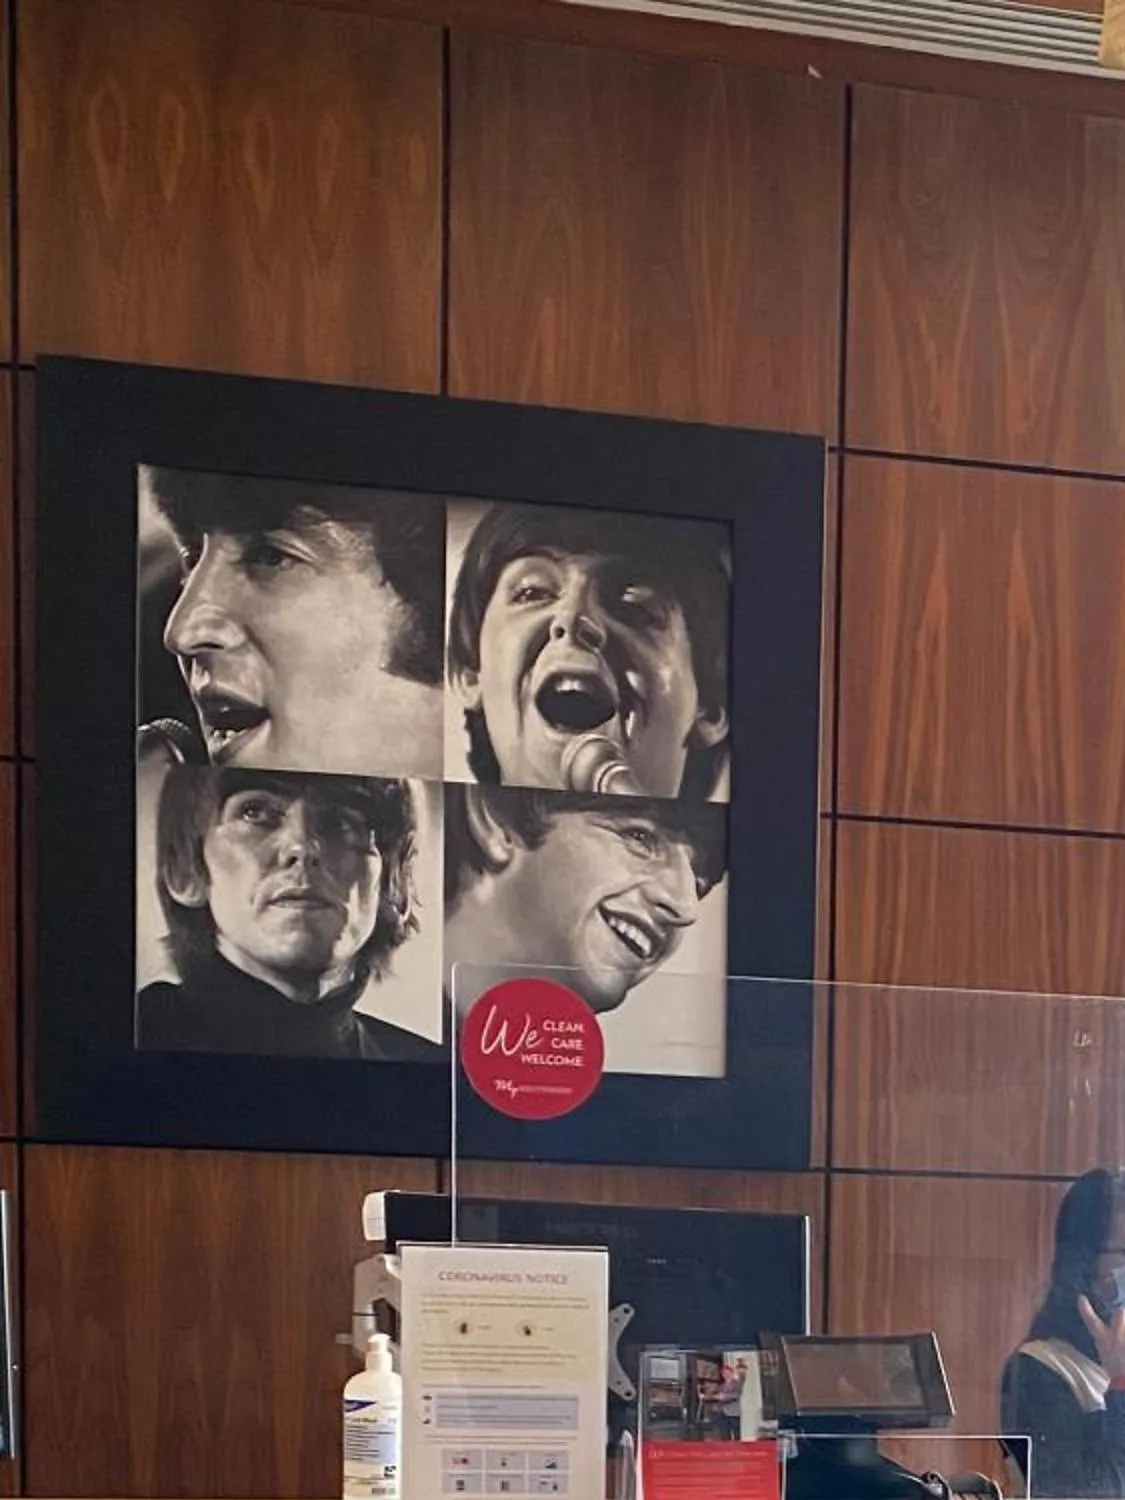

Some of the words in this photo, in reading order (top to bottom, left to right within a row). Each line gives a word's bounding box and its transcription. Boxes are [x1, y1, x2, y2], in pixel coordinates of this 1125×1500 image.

[481, 1004, 543, 1055] We
[543, 1019, 584, 1033] CLEAN
[551, 1037, 583, 1050] CARE
[521, 1053, 584, 1067] WELCOME
[438, 1270, 523, 1285] CORONAVIRUS
[526, 1274, 569, 1286] NOTICE
